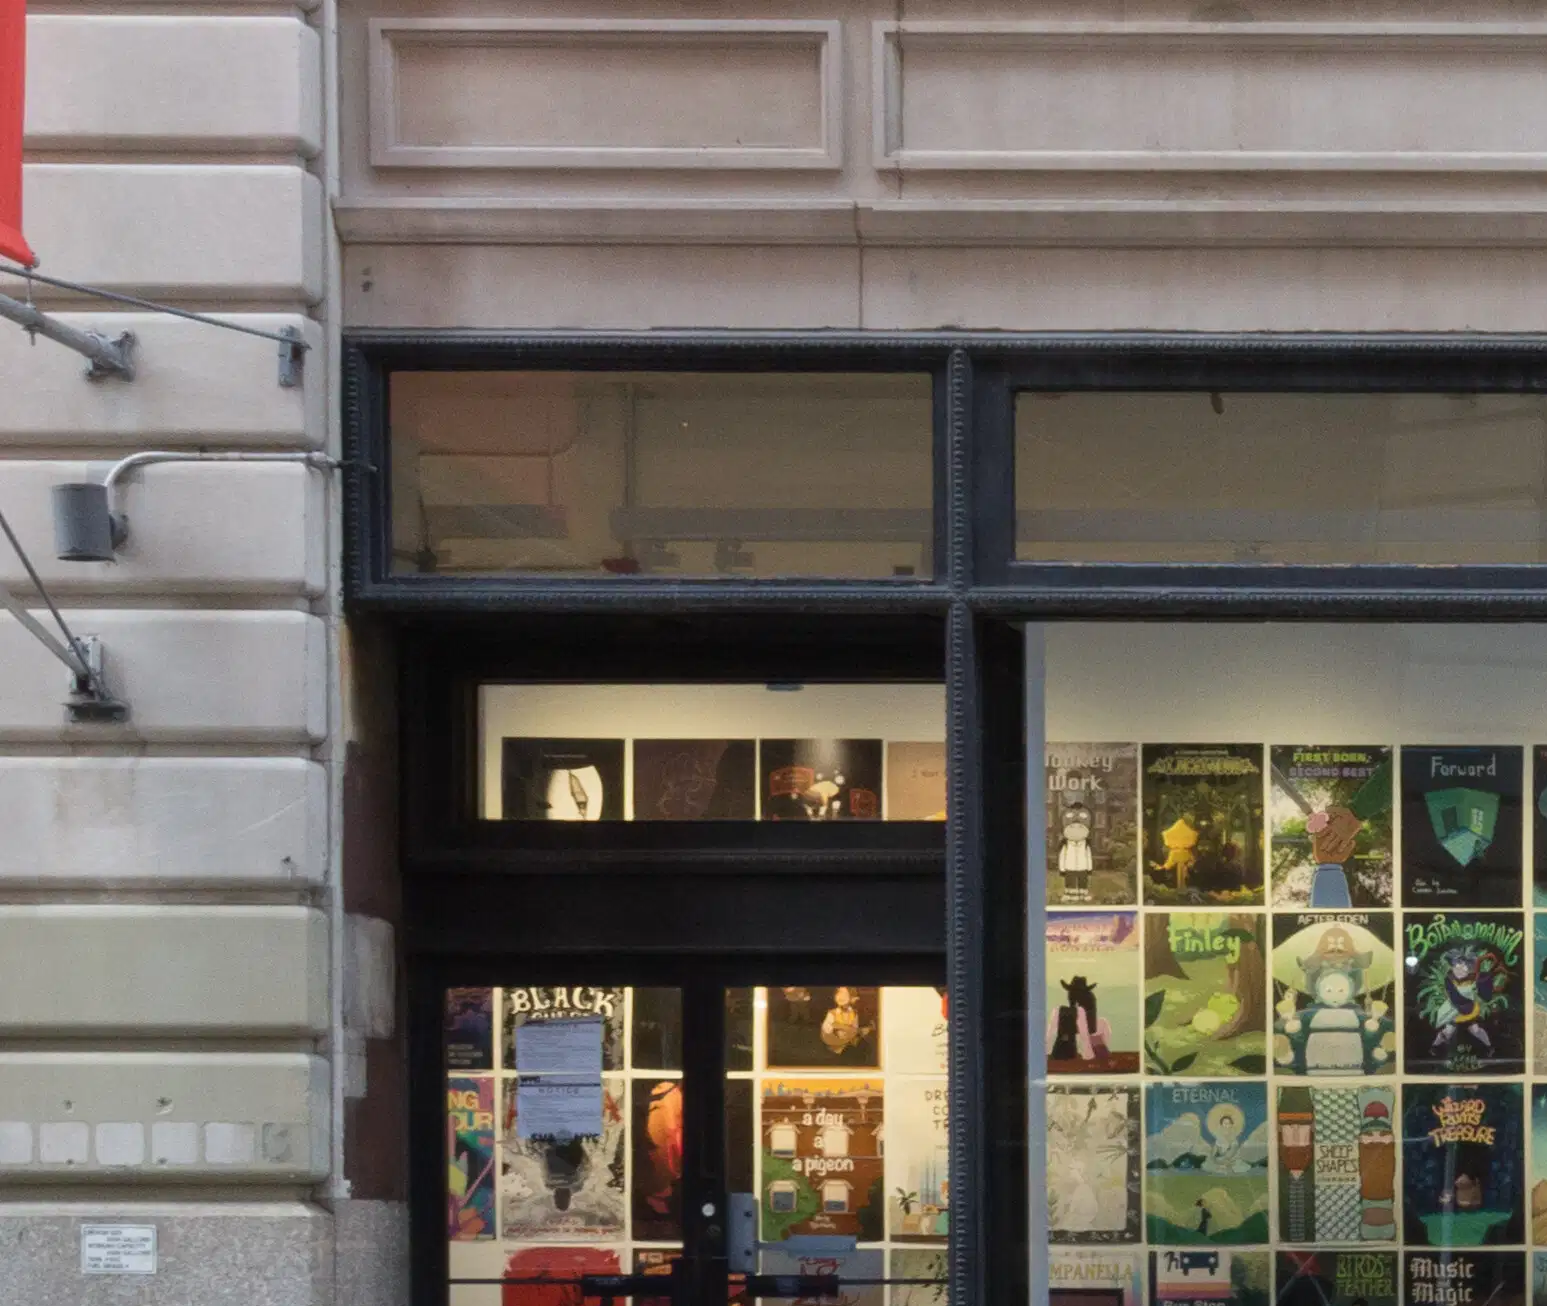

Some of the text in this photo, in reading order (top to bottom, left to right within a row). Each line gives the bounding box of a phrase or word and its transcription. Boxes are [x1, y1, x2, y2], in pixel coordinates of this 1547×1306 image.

[1045, 755, 1113, 772] onkey
[1293, 752, 1330, 763] FIRST
[1431, 753, 1497, 778] Forward
[1289, 766, 1374, 777] SECOND BEST
[1048, 775, 1103, 791] Work
[1297, 914, 1369, 925] AFTER EDEN
[1168, 929, 1241, 965] Finley
[511, 987, 616, 1018] BLACK
[1172, 1088, 1238, 1103] ETERNAL
[802, 1108, 844, 1132] a day
[1428, 1127, 1497, 1148] TREASURE
[1319, 1145, 1353, 1159] SHEEP
[793, 1155, 855, 1176] a pigeon
[1316, 1159, 1358, 1174] SHAPES
[1410, 1257, 1476, 1280] Music
[1336, 1279, 1396, 1297] FEATHER
